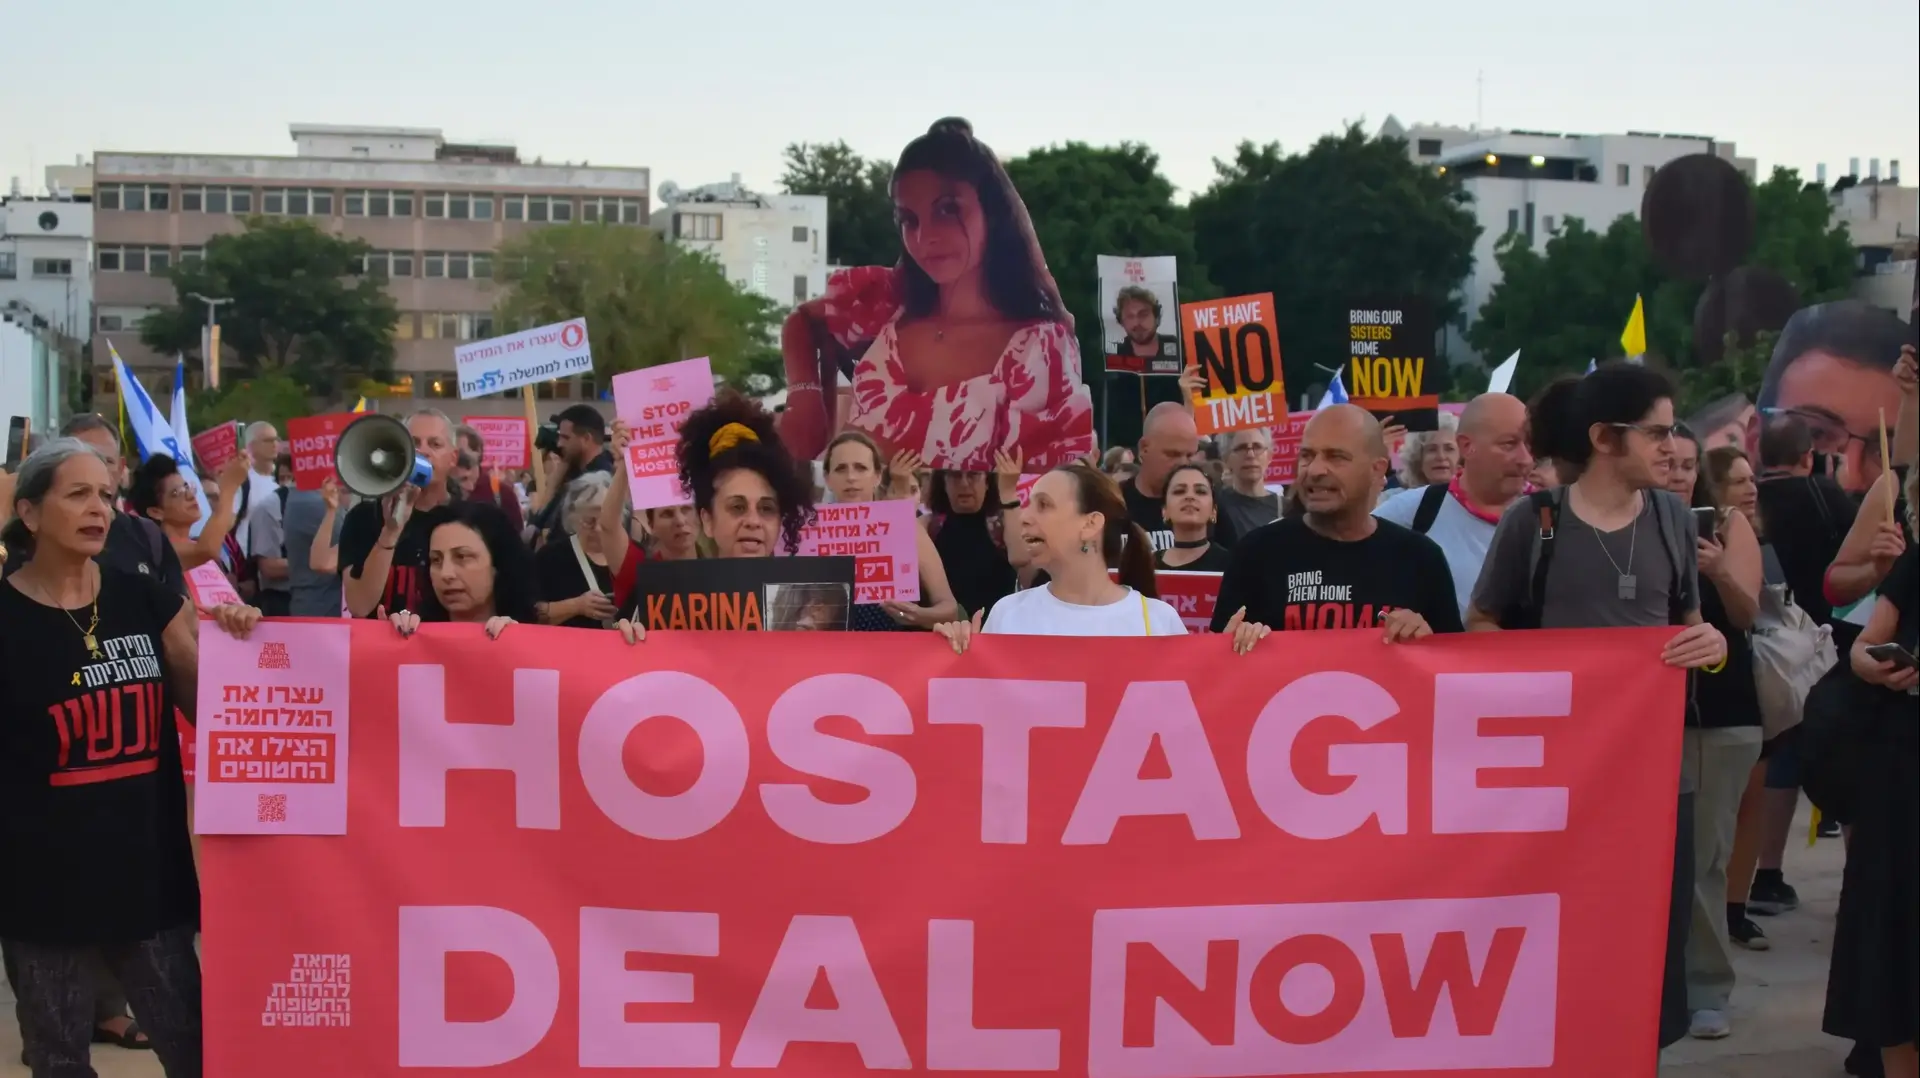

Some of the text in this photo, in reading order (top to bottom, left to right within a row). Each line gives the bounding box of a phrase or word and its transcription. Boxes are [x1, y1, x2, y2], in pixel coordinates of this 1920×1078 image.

[1193, 301, 1262, 328] WE HAVE
[1350, 309, 1403, 324] BRING OUR
[1350, 325, 1391, 340] SISTERS
[459, 331, 557, 364] עצרו את המדינה
[1351, 341, 1379, 355] HOME
[565, 355, 589, 369] עזרו
[1194, 322, 1274, 398] NO
[508, 359, 560, 382] לממשלה
[1351, 356, 1424, 398] NOW
[643, 401, 690, 420] STOP
[1206, 392, 1274, 429] TIME!
[629, 424, 665, 441] THE
[293, 434, 337, 453] HOST
[637, 443, 676, 459] SAVE
[295, 454, 335, 472] DEAL
[633, 460, 678, 474] HOST
[866, 521, 890, 536] לא
[862, 562, 889, 579] רק
[1288, 570, 1322, 589] BRING
[1287, 585, 1352, 602] THEM HOME
[647, 592, 763, 631] KARINA
[81, 660, 132, 688] הביתה
[223, 685, 324, 704] עצרו את
[48, 682, 164, 767] עכשיו
[213, 708, 332, 727] המלחמה-
[217, 737, 328, 756] הצילו את
[399, 664, 1572, 844] HOSTAGE
[220, 761, 328, 779] החטופים
[293, 954, 350, 968] מחאת
[291, 968, 350, 983] הנשים
[271, 980, 350, 997] להחזרת
[399, 906, 1060, 1070] DEAL
[1123, 927, 1526, 1047] NOW
[266, 996, 350, 1012] החטופות
[262, 1012, 350, 1026] והחטופים
